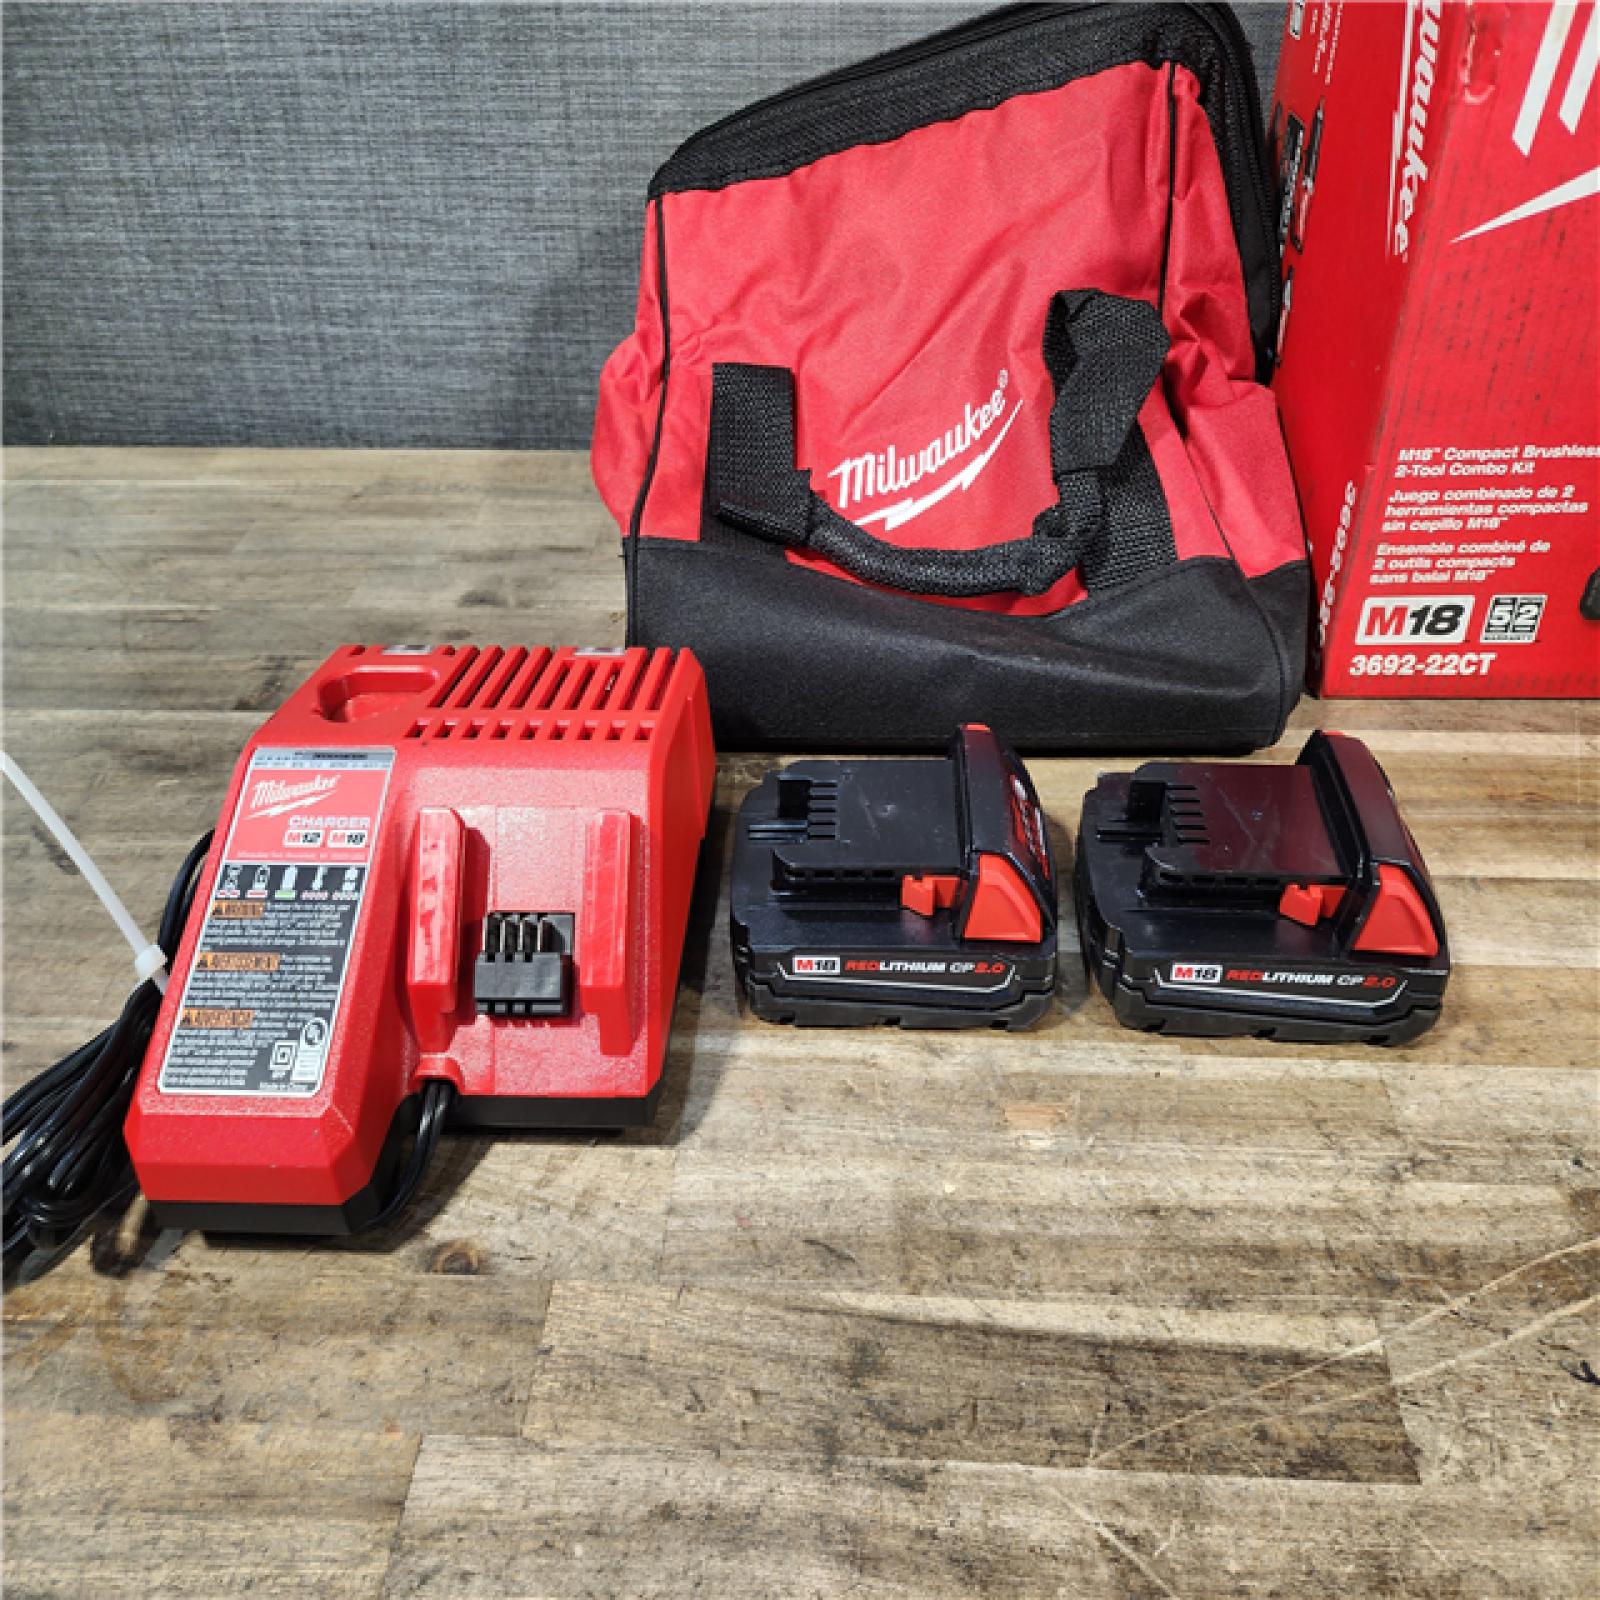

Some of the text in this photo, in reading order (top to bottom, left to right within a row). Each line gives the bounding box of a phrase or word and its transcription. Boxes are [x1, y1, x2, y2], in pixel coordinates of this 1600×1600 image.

[1444, 446, 1519, 462] Compact
[1394, 461, 1536, 477] 2-Tool Combo Kit
[1389, 485, 1576, 503] Juego combinado de 2
[1385, 500, 1588, 517] herramientas compactas
[1382, 520, 1405, 532] sin
[1410, 519, 1463, 533] cepillo
[1376, 543, 1454, 555] Ensemble
[1529, 540, 1550, 552] de
[1372, 558, 1385, 570] 2
[1364, 604, 1465, 636] M18
[1349, 652, 1497, 676] 3692-22CT
[796, 959, 836, 972] M18
[845, 960, 946, 973] REDLITHIUM
[1174, 966, 1218, 981] M18
[1226, 969, 1334, 985] REDLITHIUM
